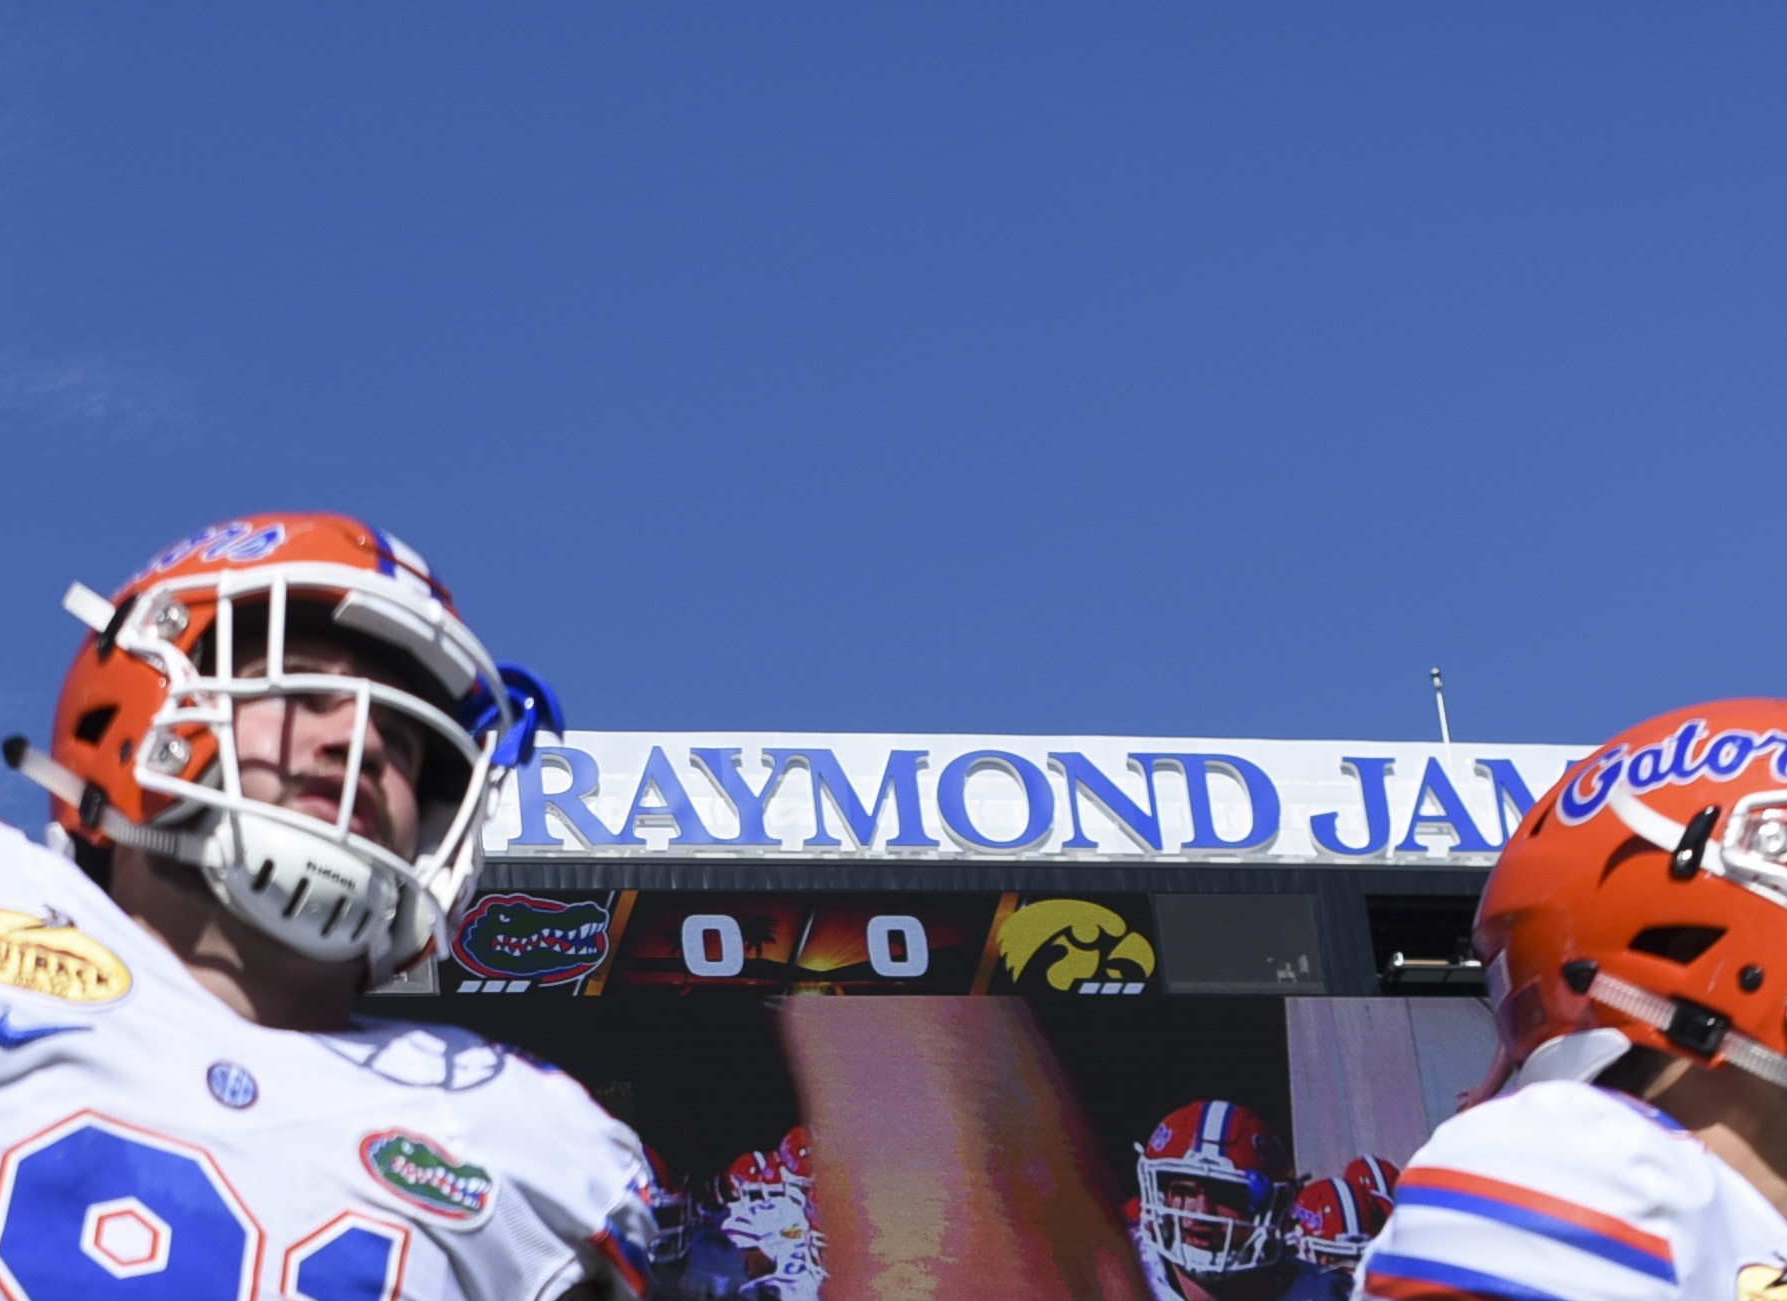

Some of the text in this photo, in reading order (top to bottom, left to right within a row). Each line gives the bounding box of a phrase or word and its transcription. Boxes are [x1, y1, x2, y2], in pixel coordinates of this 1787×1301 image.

[508, 743, 1281, 854] RAYMOND
[1309, 754, 1577, 860] JAM
[681, 912, 930, 978] 0 0
